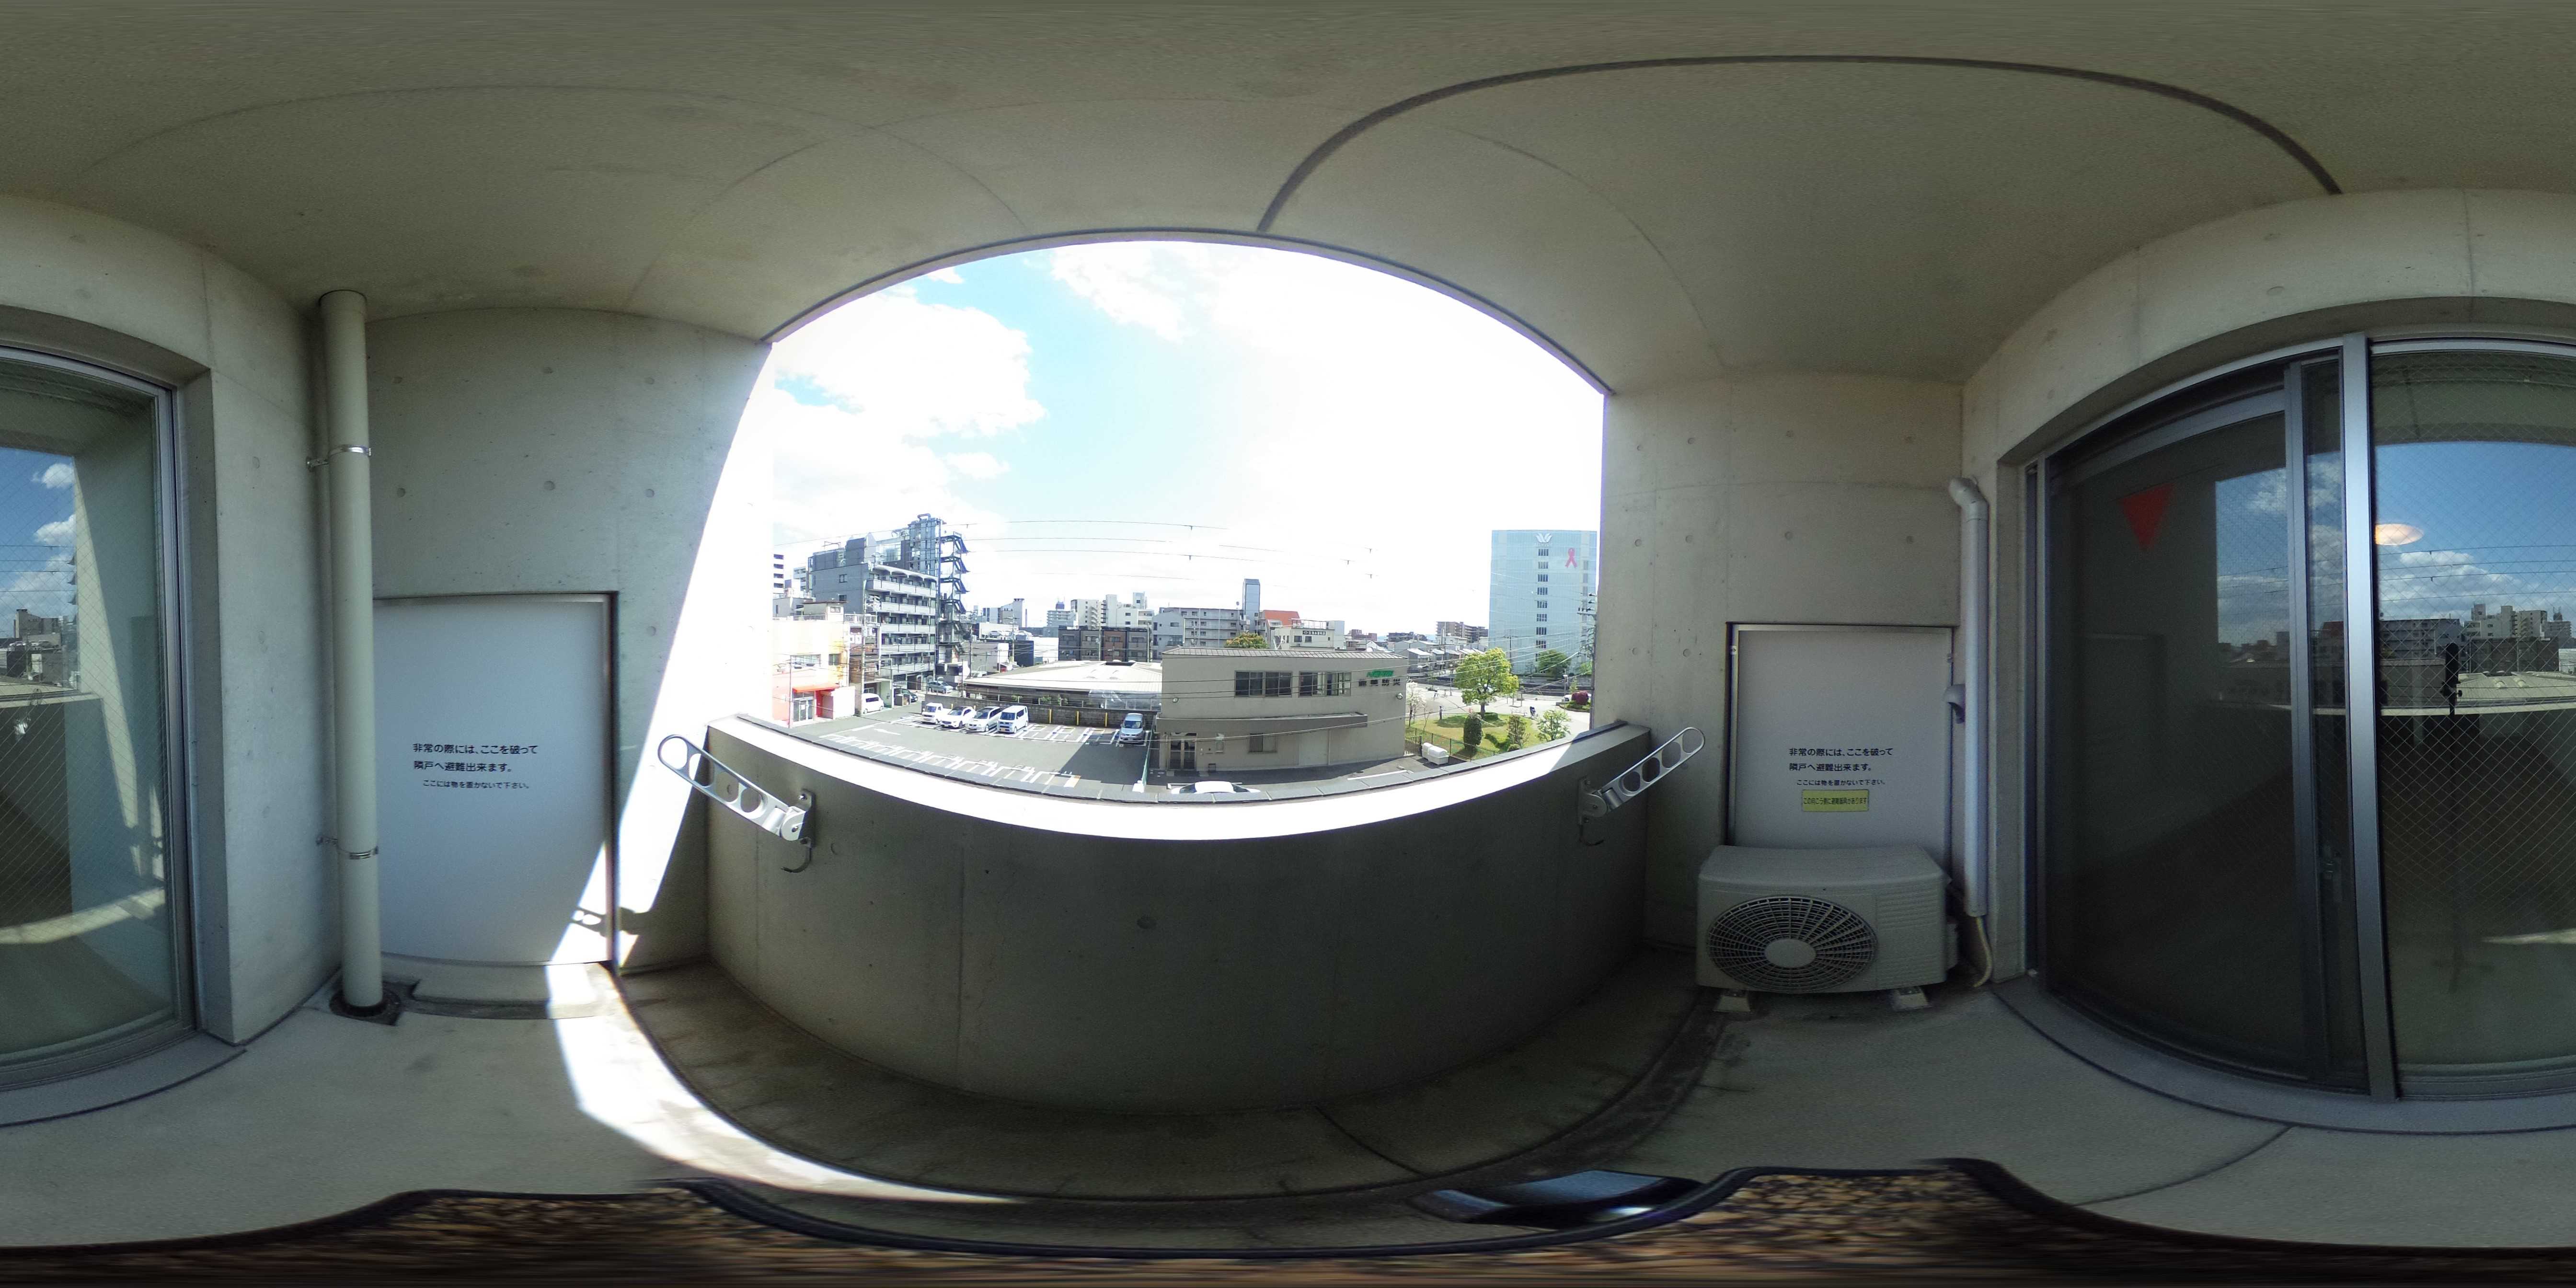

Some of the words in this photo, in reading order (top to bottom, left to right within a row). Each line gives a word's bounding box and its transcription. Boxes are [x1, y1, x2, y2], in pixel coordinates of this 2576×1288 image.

[412, 743, 538, 755] 非常の際には、ここを破って
[1789, 748, 1893, 757] 非常の際には、ここを破って
[414, 760, 511, 772] 隣戸へ避難出来ます。
[1789, 763, 1871, 771] 隣戸へ避難出来ます。
